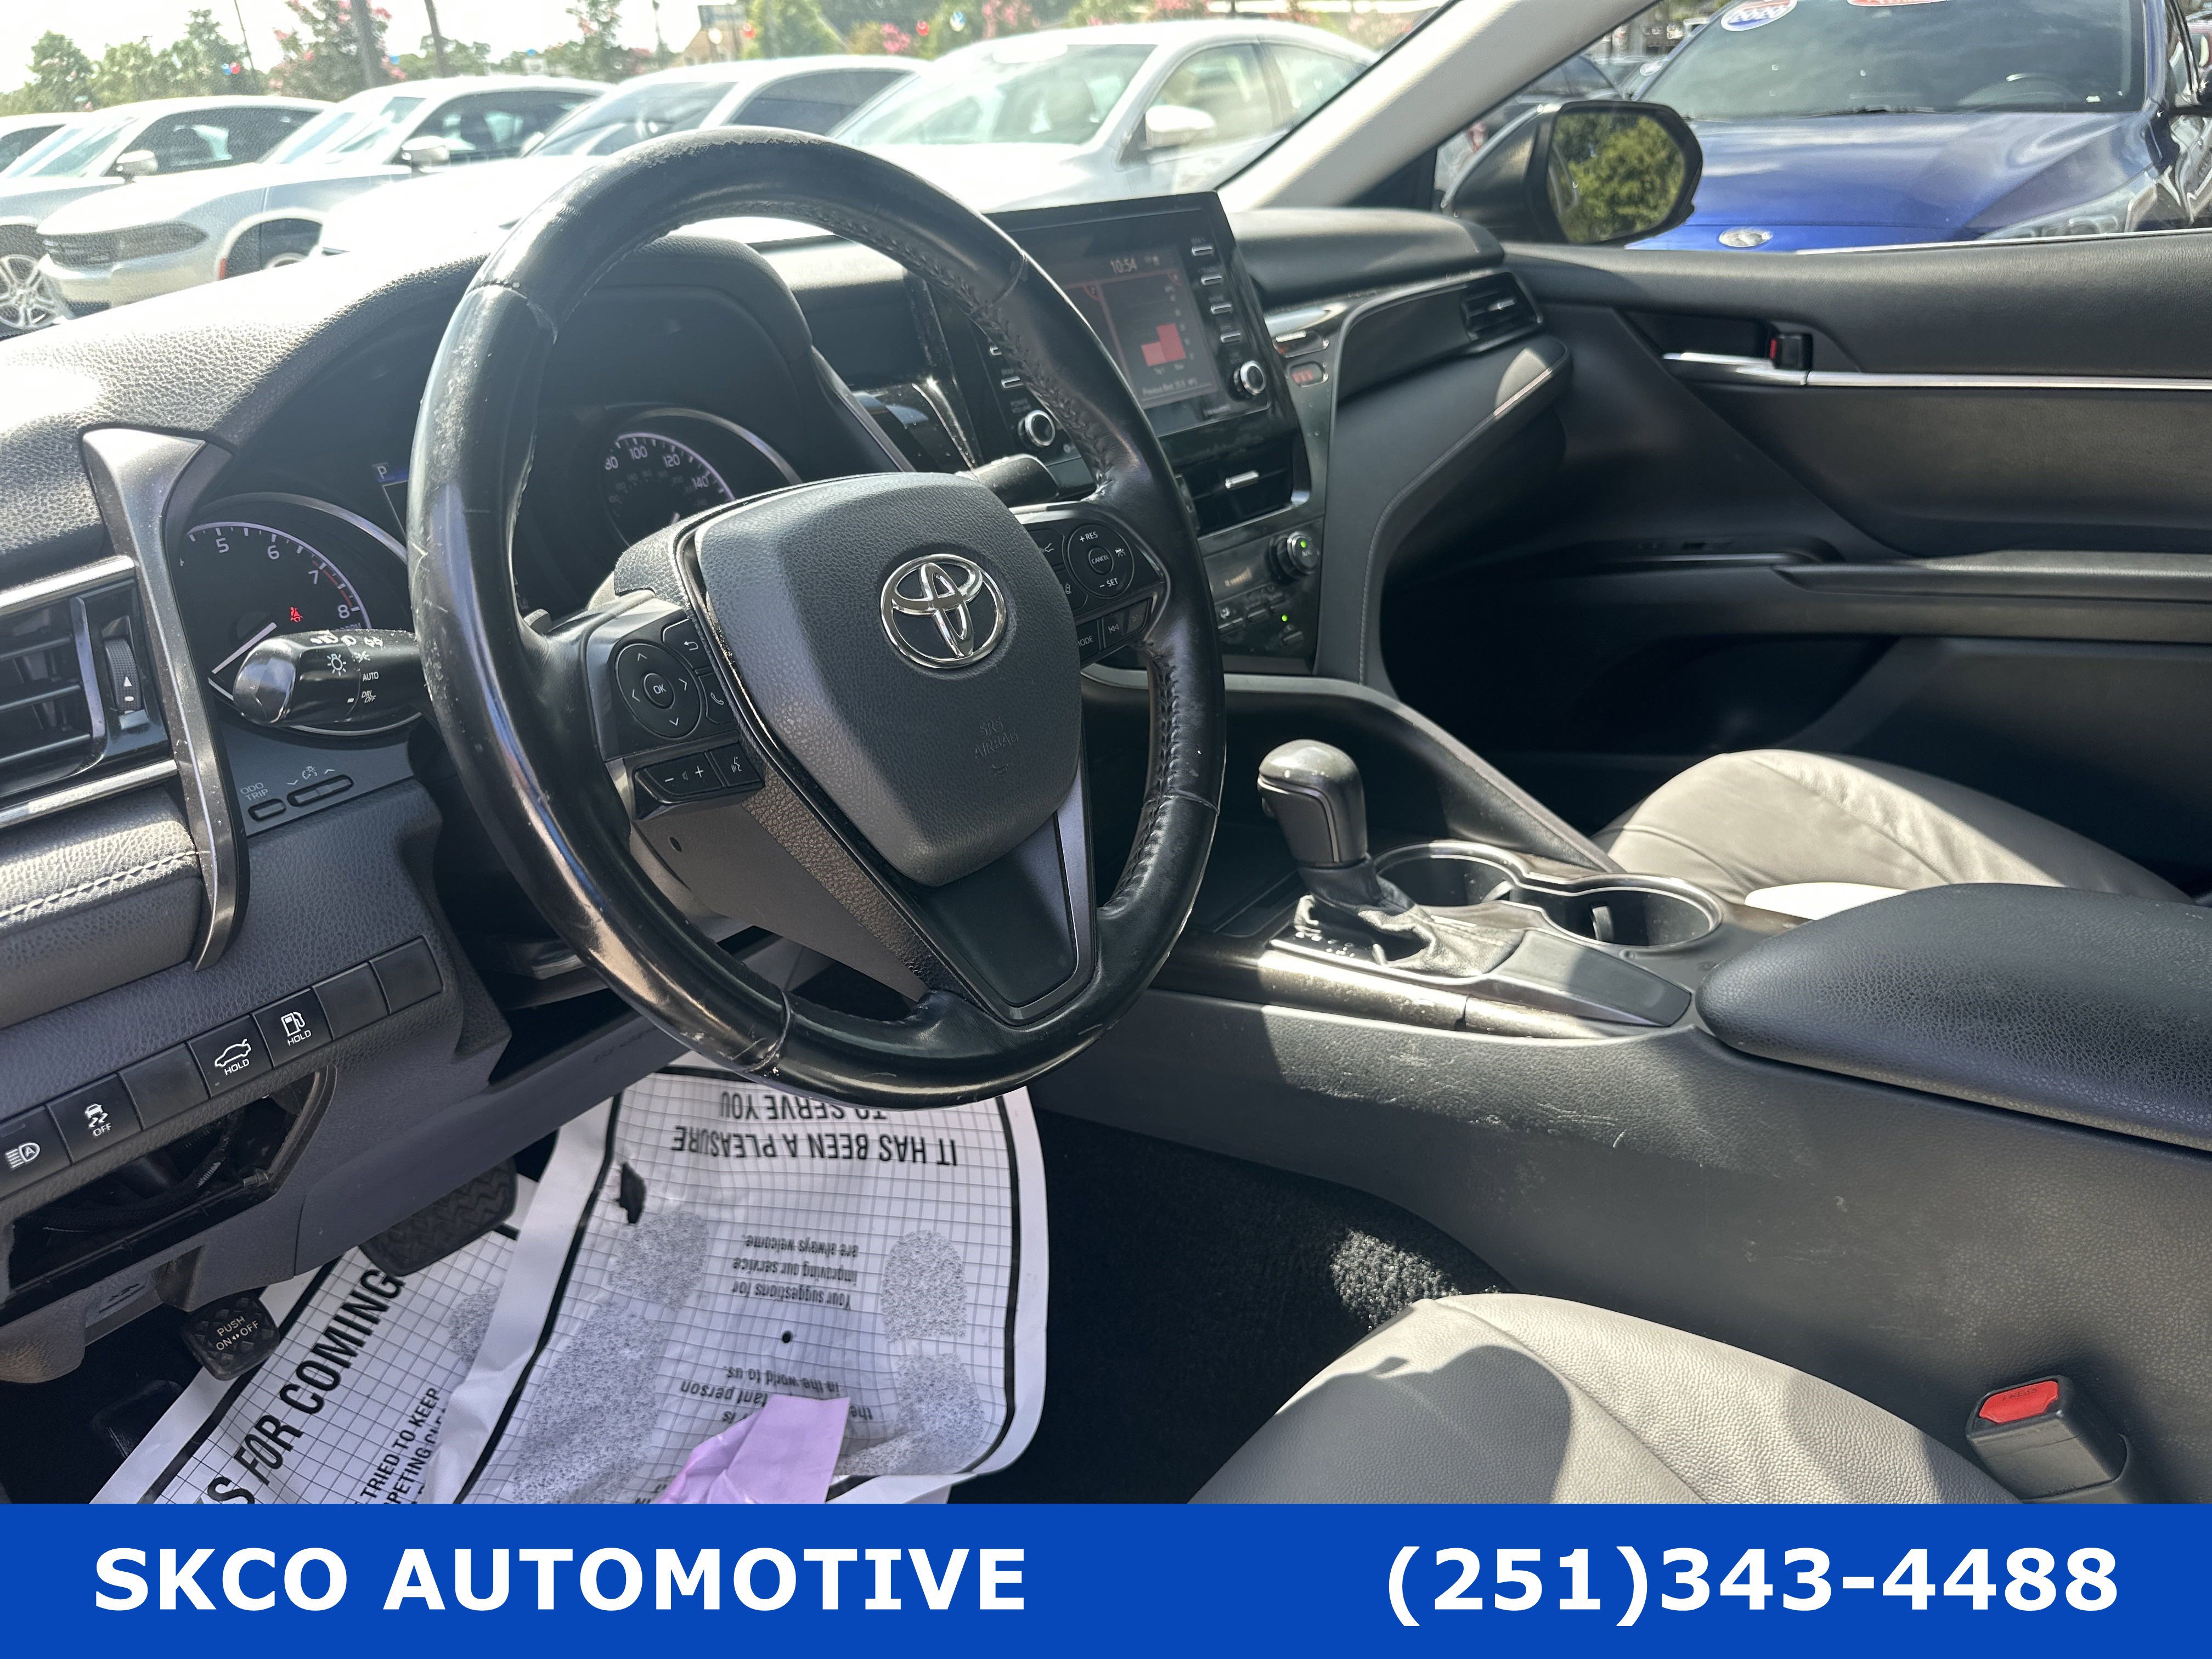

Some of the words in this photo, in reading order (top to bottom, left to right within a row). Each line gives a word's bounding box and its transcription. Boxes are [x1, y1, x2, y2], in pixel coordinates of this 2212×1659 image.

[1110, 257, 1138, 274] 10:54
[629, 445, 648, 460] 100
[663, 454, 681, 467] 120
[377, 466, 387, 479] P
[691, 476, 709, 489] 140
[216, 538, 229, 553] 5
[267, 545, 279, 560] 6
[1091, 555, 1109, 565] CANCEL
[308, 570, 319, 584] 7
[338, 605, 350, 619] 8
[363, 672, 379, 681] AUTO
[362, 690, 373, 699] DRL
[653, 684, 667, 695] OK
[979, 716, 1003, 736] SRS
[975, 729, 1019, 760] AIRBAG
[240, 782, 264, 794] ODO
[247, 788, 268, 801] TRIP
[287, 1030, 312, 1046] HOLD
[224, 1059, 250, 1075] HOLD
[719, 1091, 759, 1120] YOU
[93, 1122, 112, 1137] OFF
[672, 1126, 778, 1158] PLEASURE
[783, 1133, 798, 1157] A
[808, 1133, 870, 1160] BEEN
[879, 1134, 927, 1164] HAS
[936, 1137, 957, 1166] IT
[798, 1237, 837, 1258] always
[839, 1244, 859, 1257] are
[732, 1257, 778, 1274] service
[781, 1263, 799, 1276] our
[802, 1261, 857, 1287] improving
[732, 1280, 752, 1298] for
[755, 1283, 824, 1304] suggestions
[826, 1291, 851, 1310] Your
[217, 1316, 245, 1336] PUSH
[216, 1338, 233, 1350] ON
[240, 1320, 259, 1336] OFF
[234, 1414, 304, 1486] FOR
[279, 1269, 406, 1415] COMING
[747, 1369, 761, 1384] to
[765, 1370, 799, 1387] world
[802, 1377, 823, 1392] the
[680, 1380, 735, 1401] person
[827, 1381, 839, 1396] in
[722, 1410, 737, 1424] is
[360, 1453, 400, 1498] TRIED
[392, 1429, 416, 1449] TO
[408, 1387, 439, 1427] KEEP
